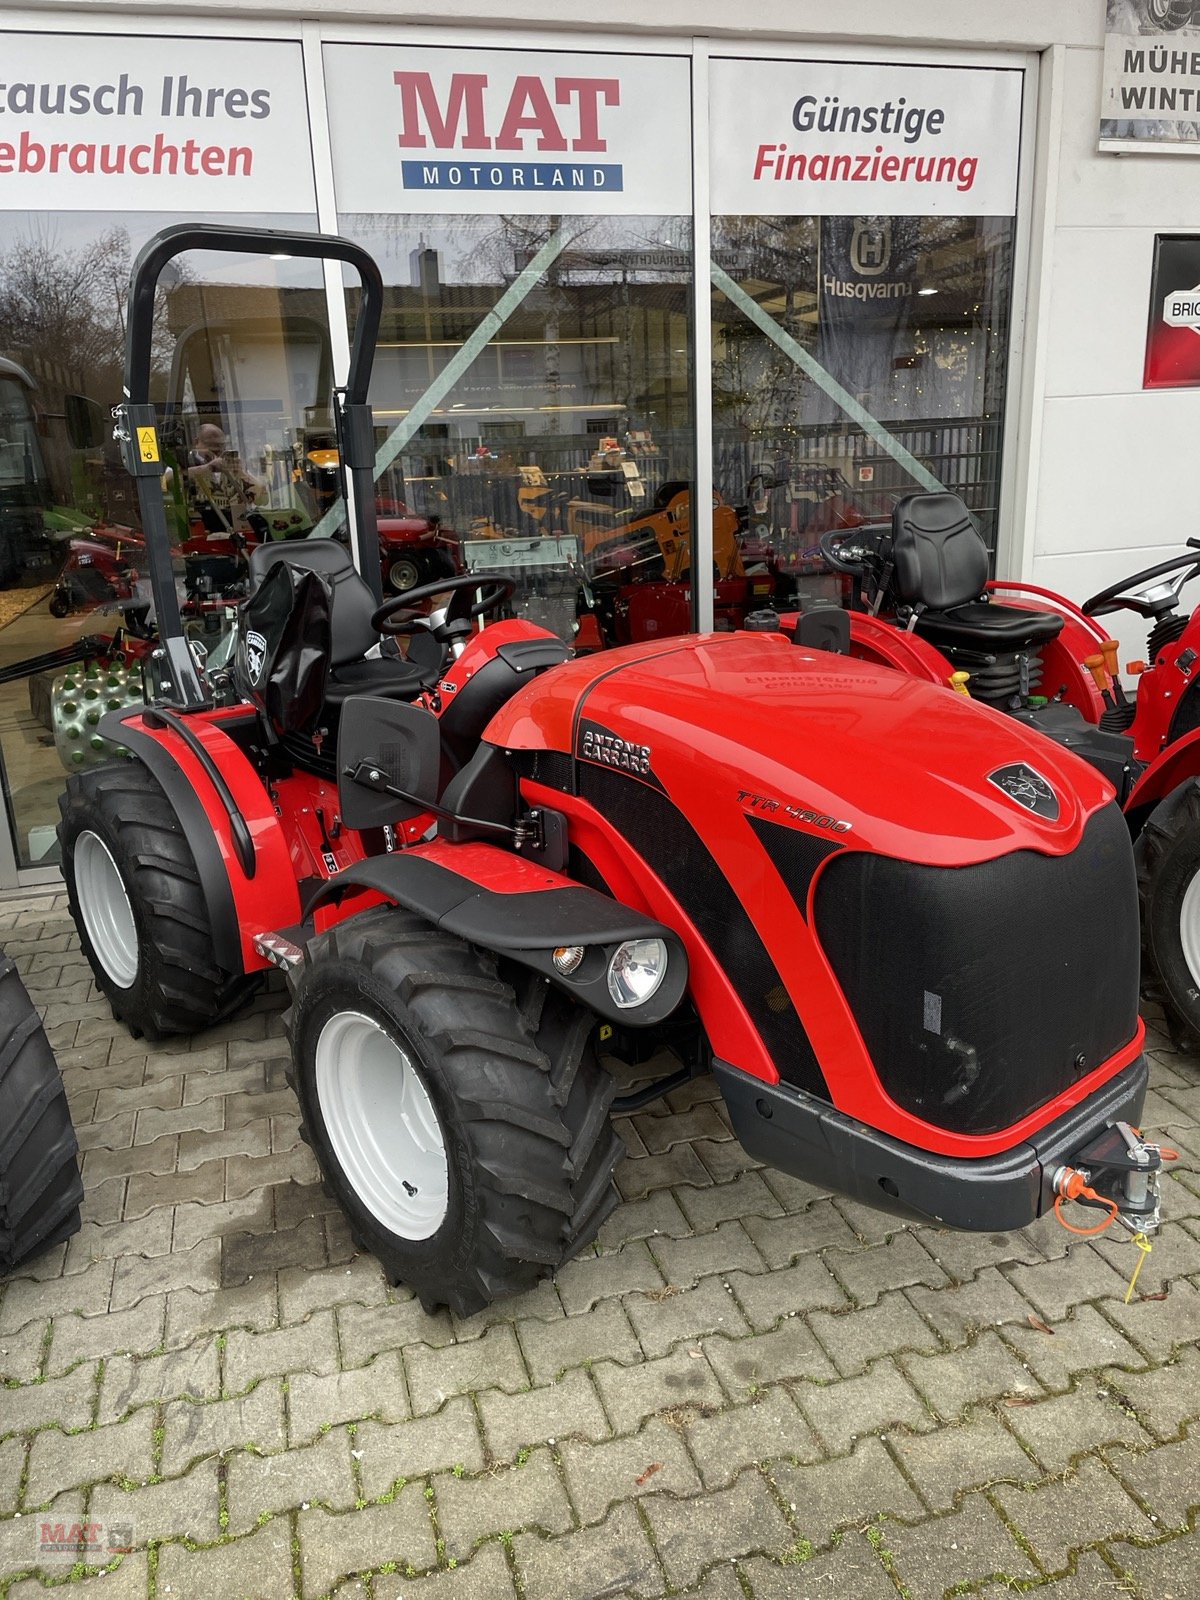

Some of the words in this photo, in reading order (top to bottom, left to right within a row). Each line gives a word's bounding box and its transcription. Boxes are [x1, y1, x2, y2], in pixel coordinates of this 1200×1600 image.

[1124, 45, 1200, 75] MÜHE
[161, 75, 271, 119] Ihres
[393, 71, 620, 152] MAT
[1121, 87, 1200, 112] WINT
[792, 95, 945, 143] Günstige
[0, 131, 253, 176] ebrauchten
[753, 143, 978, 191] Finanzierung
[423, 166, 605, 187] MOTORLAND
[583, 742, 650, 774] CARRARO
[584, 731, 650, 757] ANTONIO
[736, 790, 780, 812] TTR
[784, 805, 853, 833] 4800
